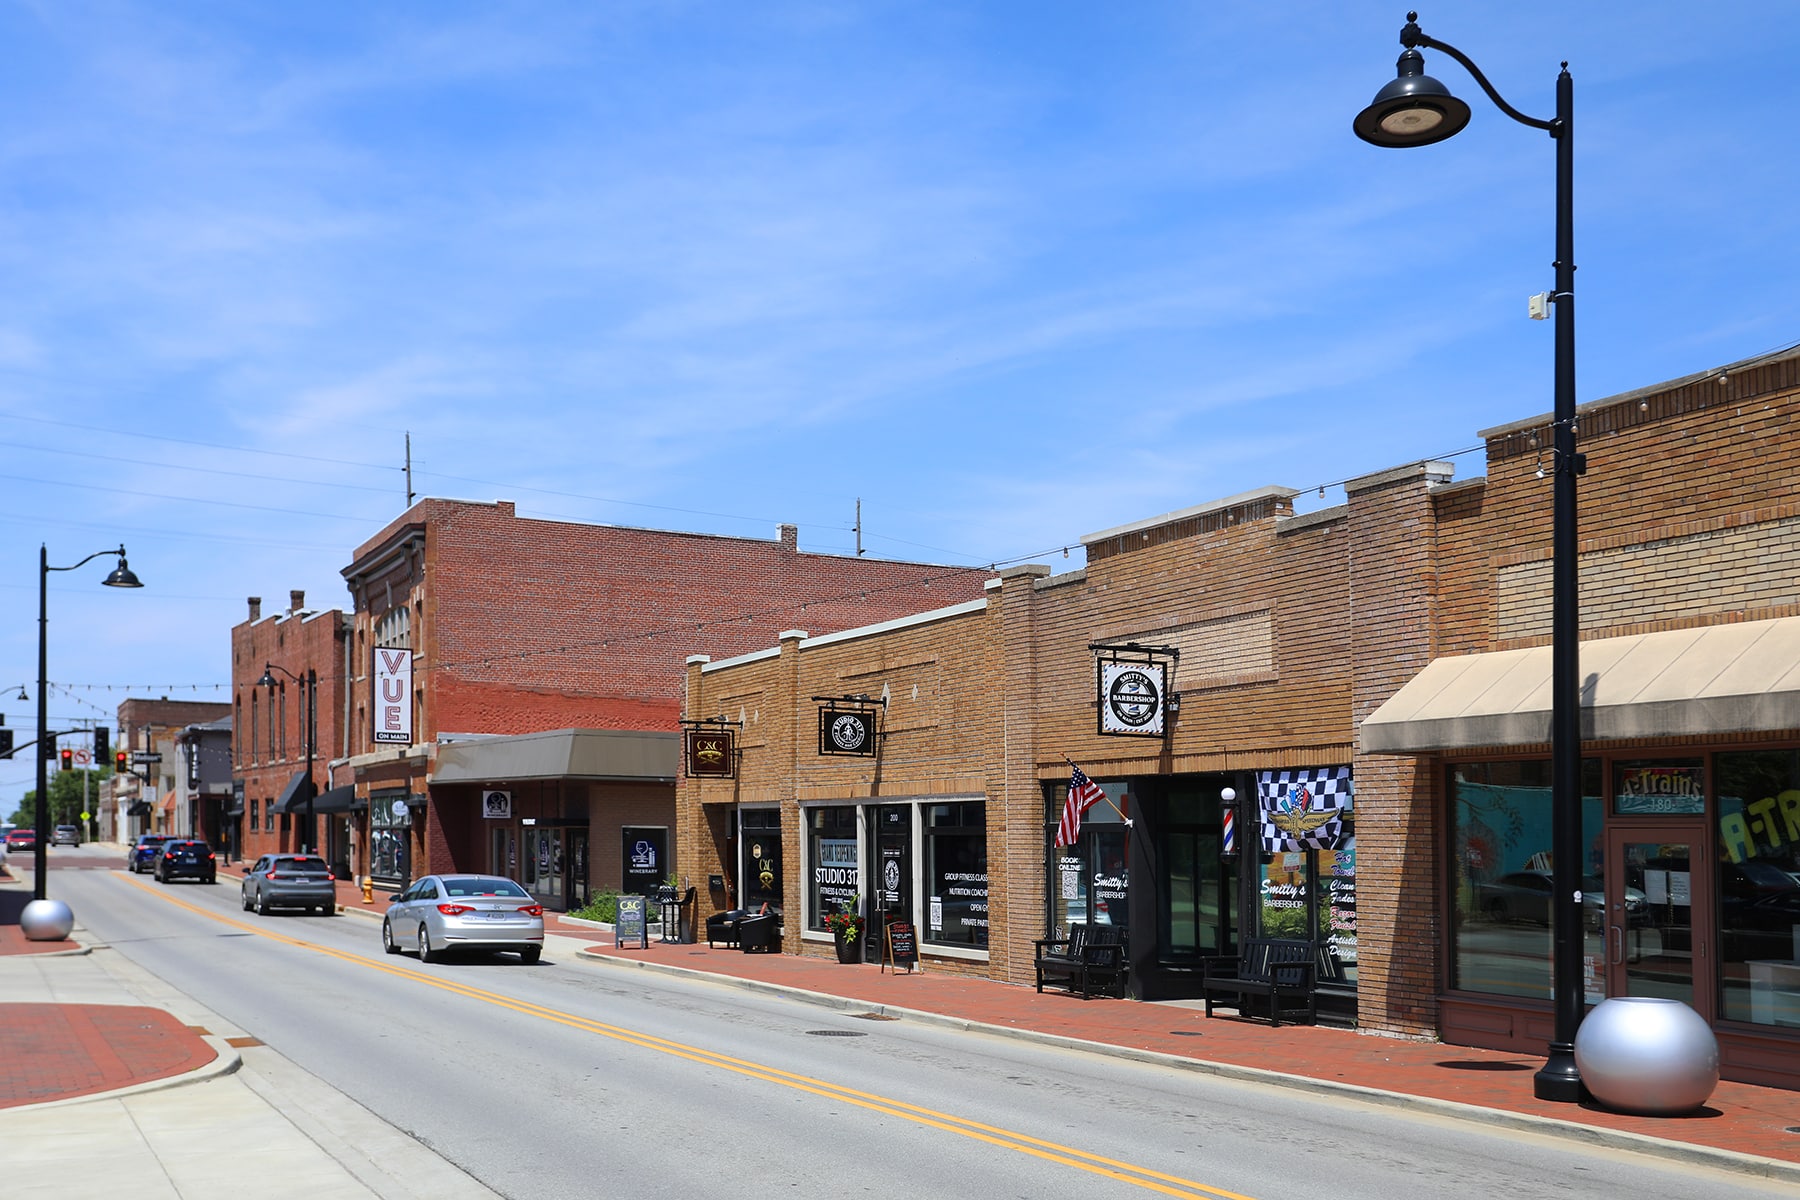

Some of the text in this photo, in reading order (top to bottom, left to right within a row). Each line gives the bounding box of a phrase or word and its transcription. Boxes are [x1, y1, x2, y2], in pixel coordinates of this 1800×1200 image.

[1119, 673, 1149, 685] SMITTY'S
[381, 651, 406, 731] VUE
[1112, 694, 1156, 704] BARBERSHOP
[834, 716, 863, 731] STUDIO 317
[1122, 715, 1133, 724] MAIN
[696, 740, 723, 750] C&C
[1622, 768, 1701, 802] A-Trains
[889, 813, 899, 822] 200
[815, 867, 846, 885] STUDIO
[944, 872, 958, 881] GROUP
[959, 873, 975, 881] FITNESS
[1094, 873, 1128, 890] Smitty's
[1260, 879, 1306, 899] Smitty's
[1330, 879, 1354, 891] Clean
[819, 886, 835, 895] FITNESS
[838, 888, 856, 897] CYCLING
[1096, 890, 1126, 899] BARBERSHOP
[1330, 892, 1355, 903] Fades
[620, 900, 641, 911] C&C
[1264, 899, 1303, 909] BARBERSHOP
[1330, 906, 1355, 919] Razor
[961, 918, 976, 926] PRIVATE
[1330, 919, 1356, 930] Finish
